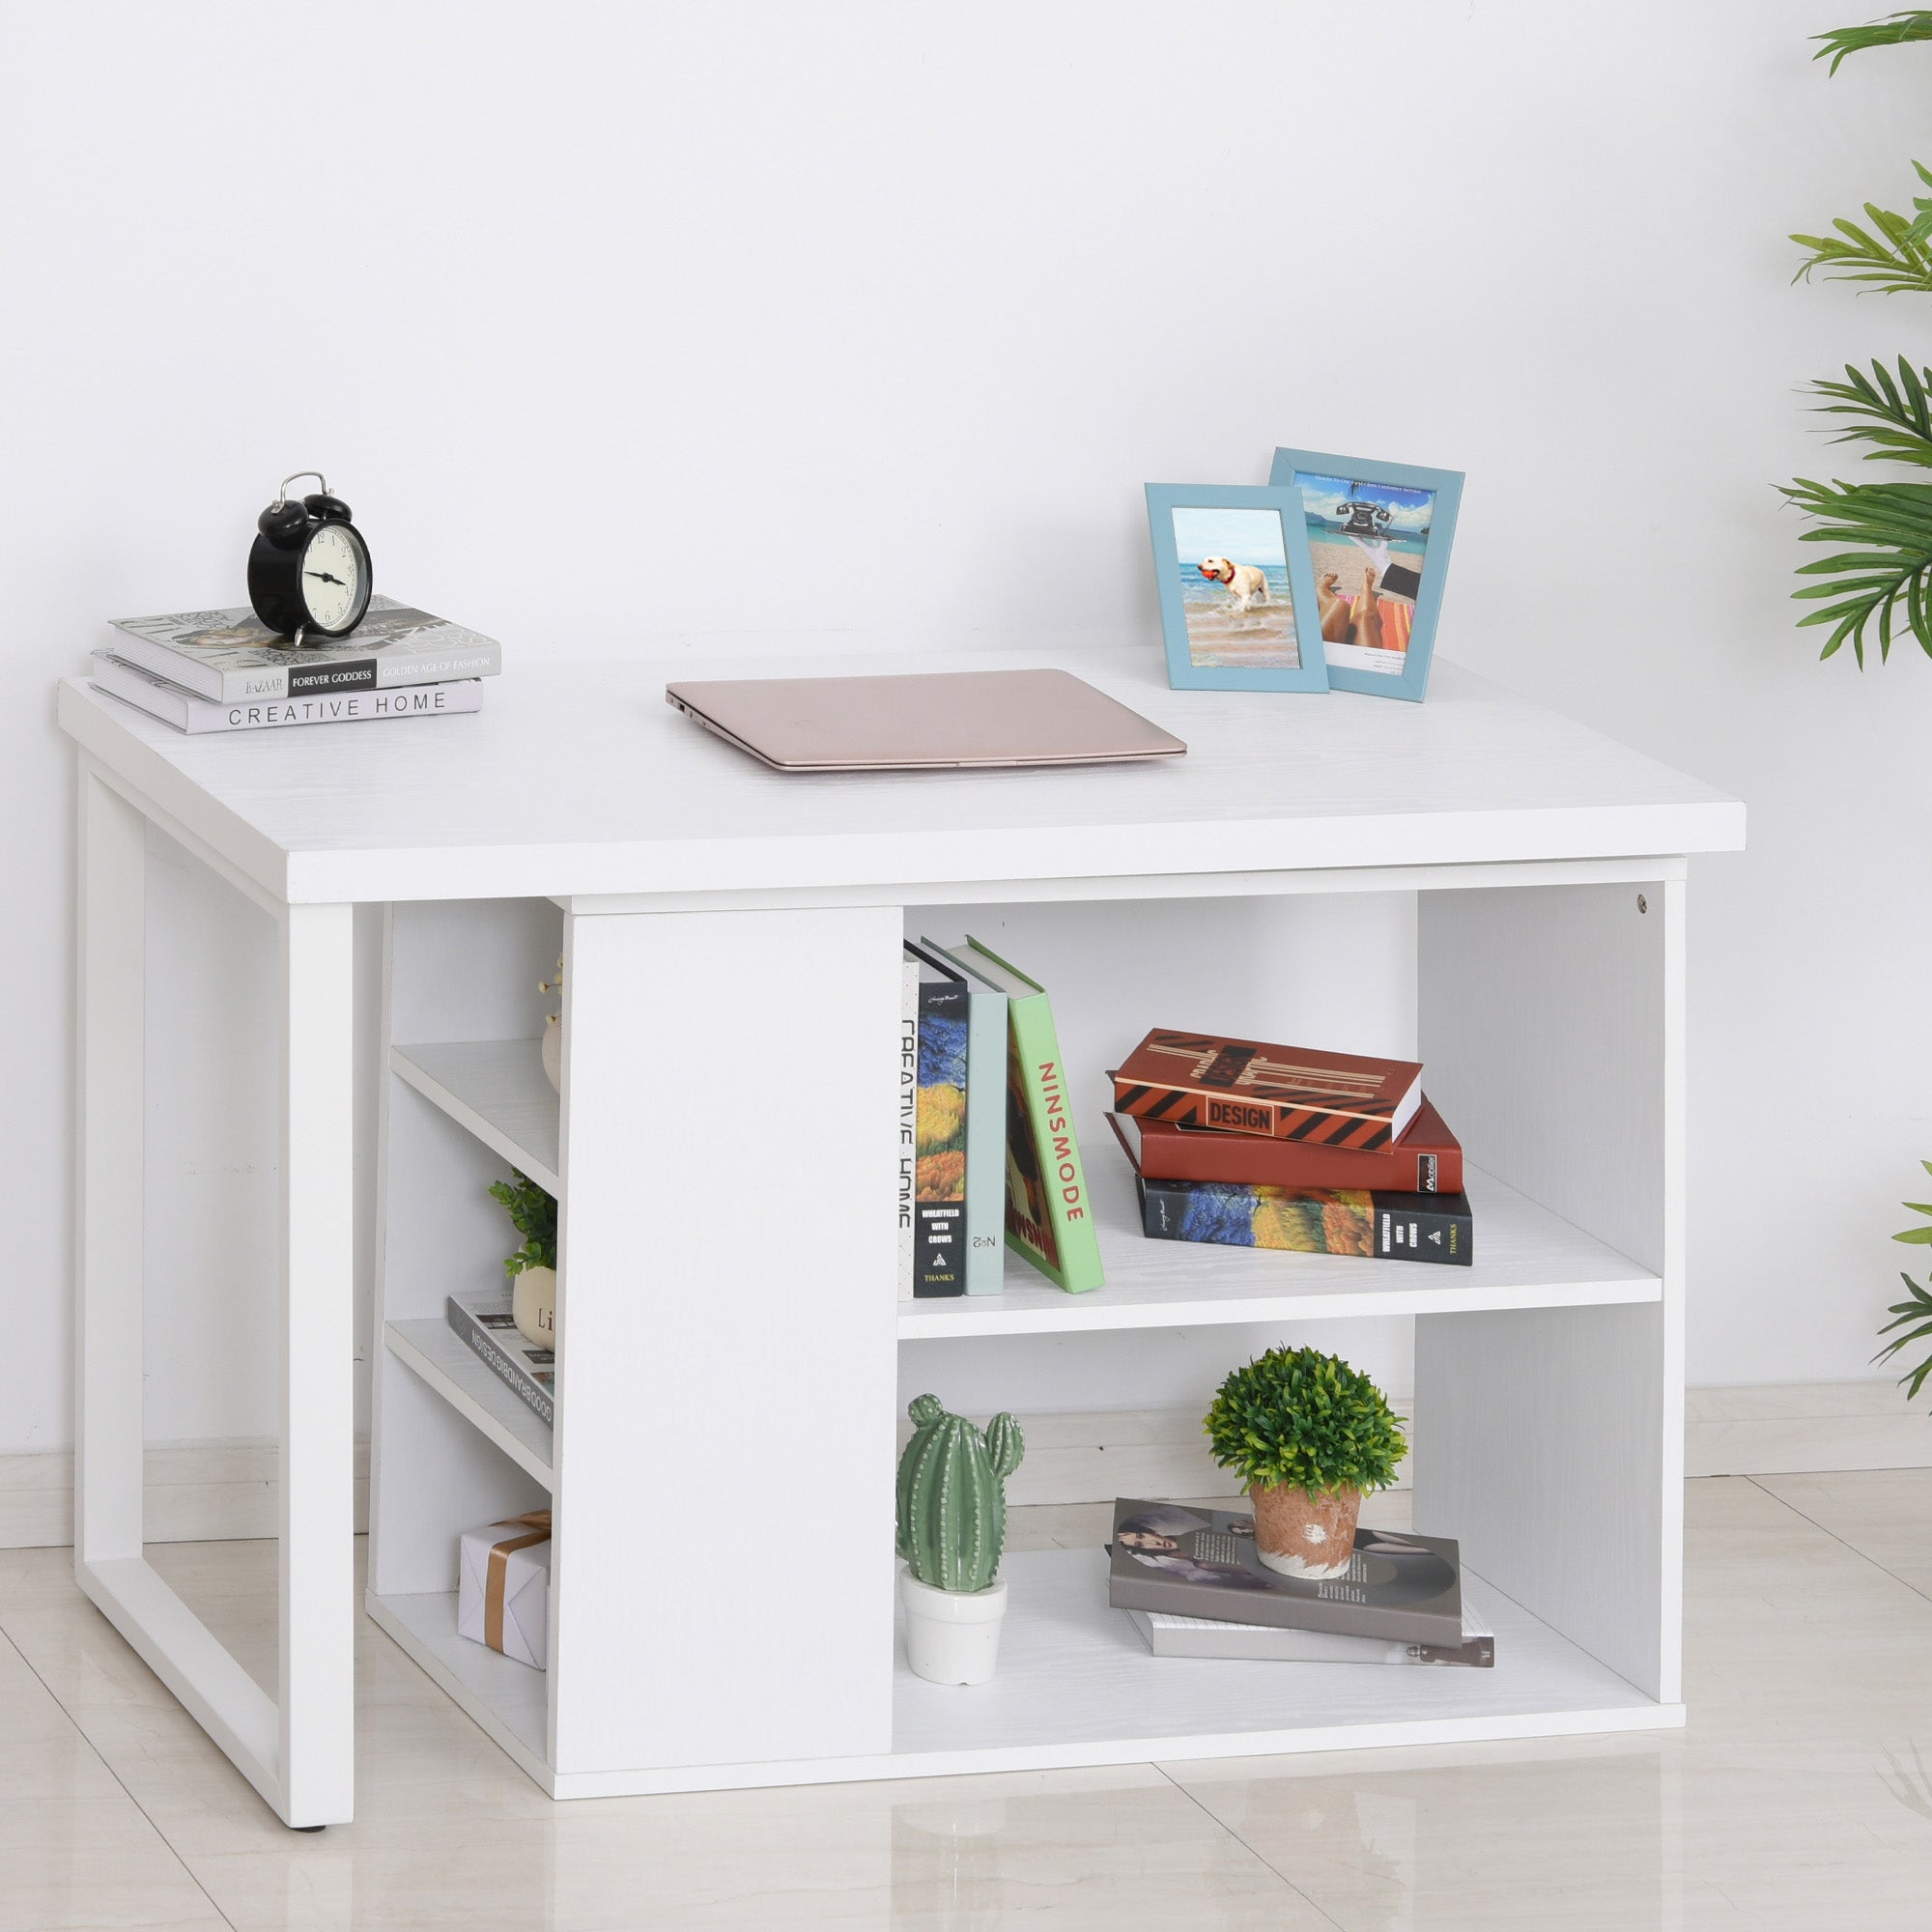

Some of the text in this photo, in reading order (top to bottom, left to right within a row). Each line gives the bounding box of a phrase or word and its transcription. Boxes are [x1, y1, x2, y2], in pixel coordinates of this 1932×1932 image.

[317, 532, 325, 544] 12
[293, 674, 329, 688] FOREVER
[331, 669, 372, 683] GODDESS
[383, 666, 418, 677] GOLDEN
[420, 663, 438, 674] AGE
[439, 661, 451, 671] OF
[453, 656, 492, 669] FASHION
[228, 692, 446, 725] CREATIVE HOME
[1209, 1102, 1270, 1129] DESIGN
[1038, 1062, 1084, 1222] NINSMODE
[922, 1208, 960, 1218] WHEATFIELD
[931, 1222, 950, 1231] WITH
[1382, 1213, 1391, 1253] WHEATFIELD
[1396, 1225, 1405, 1244] WITH
[1408, 1223, 1418, 1248] CROWS
[928, 1235, 952, 1244] CROWS
[924, 1273, 954, 1283] THANKS
